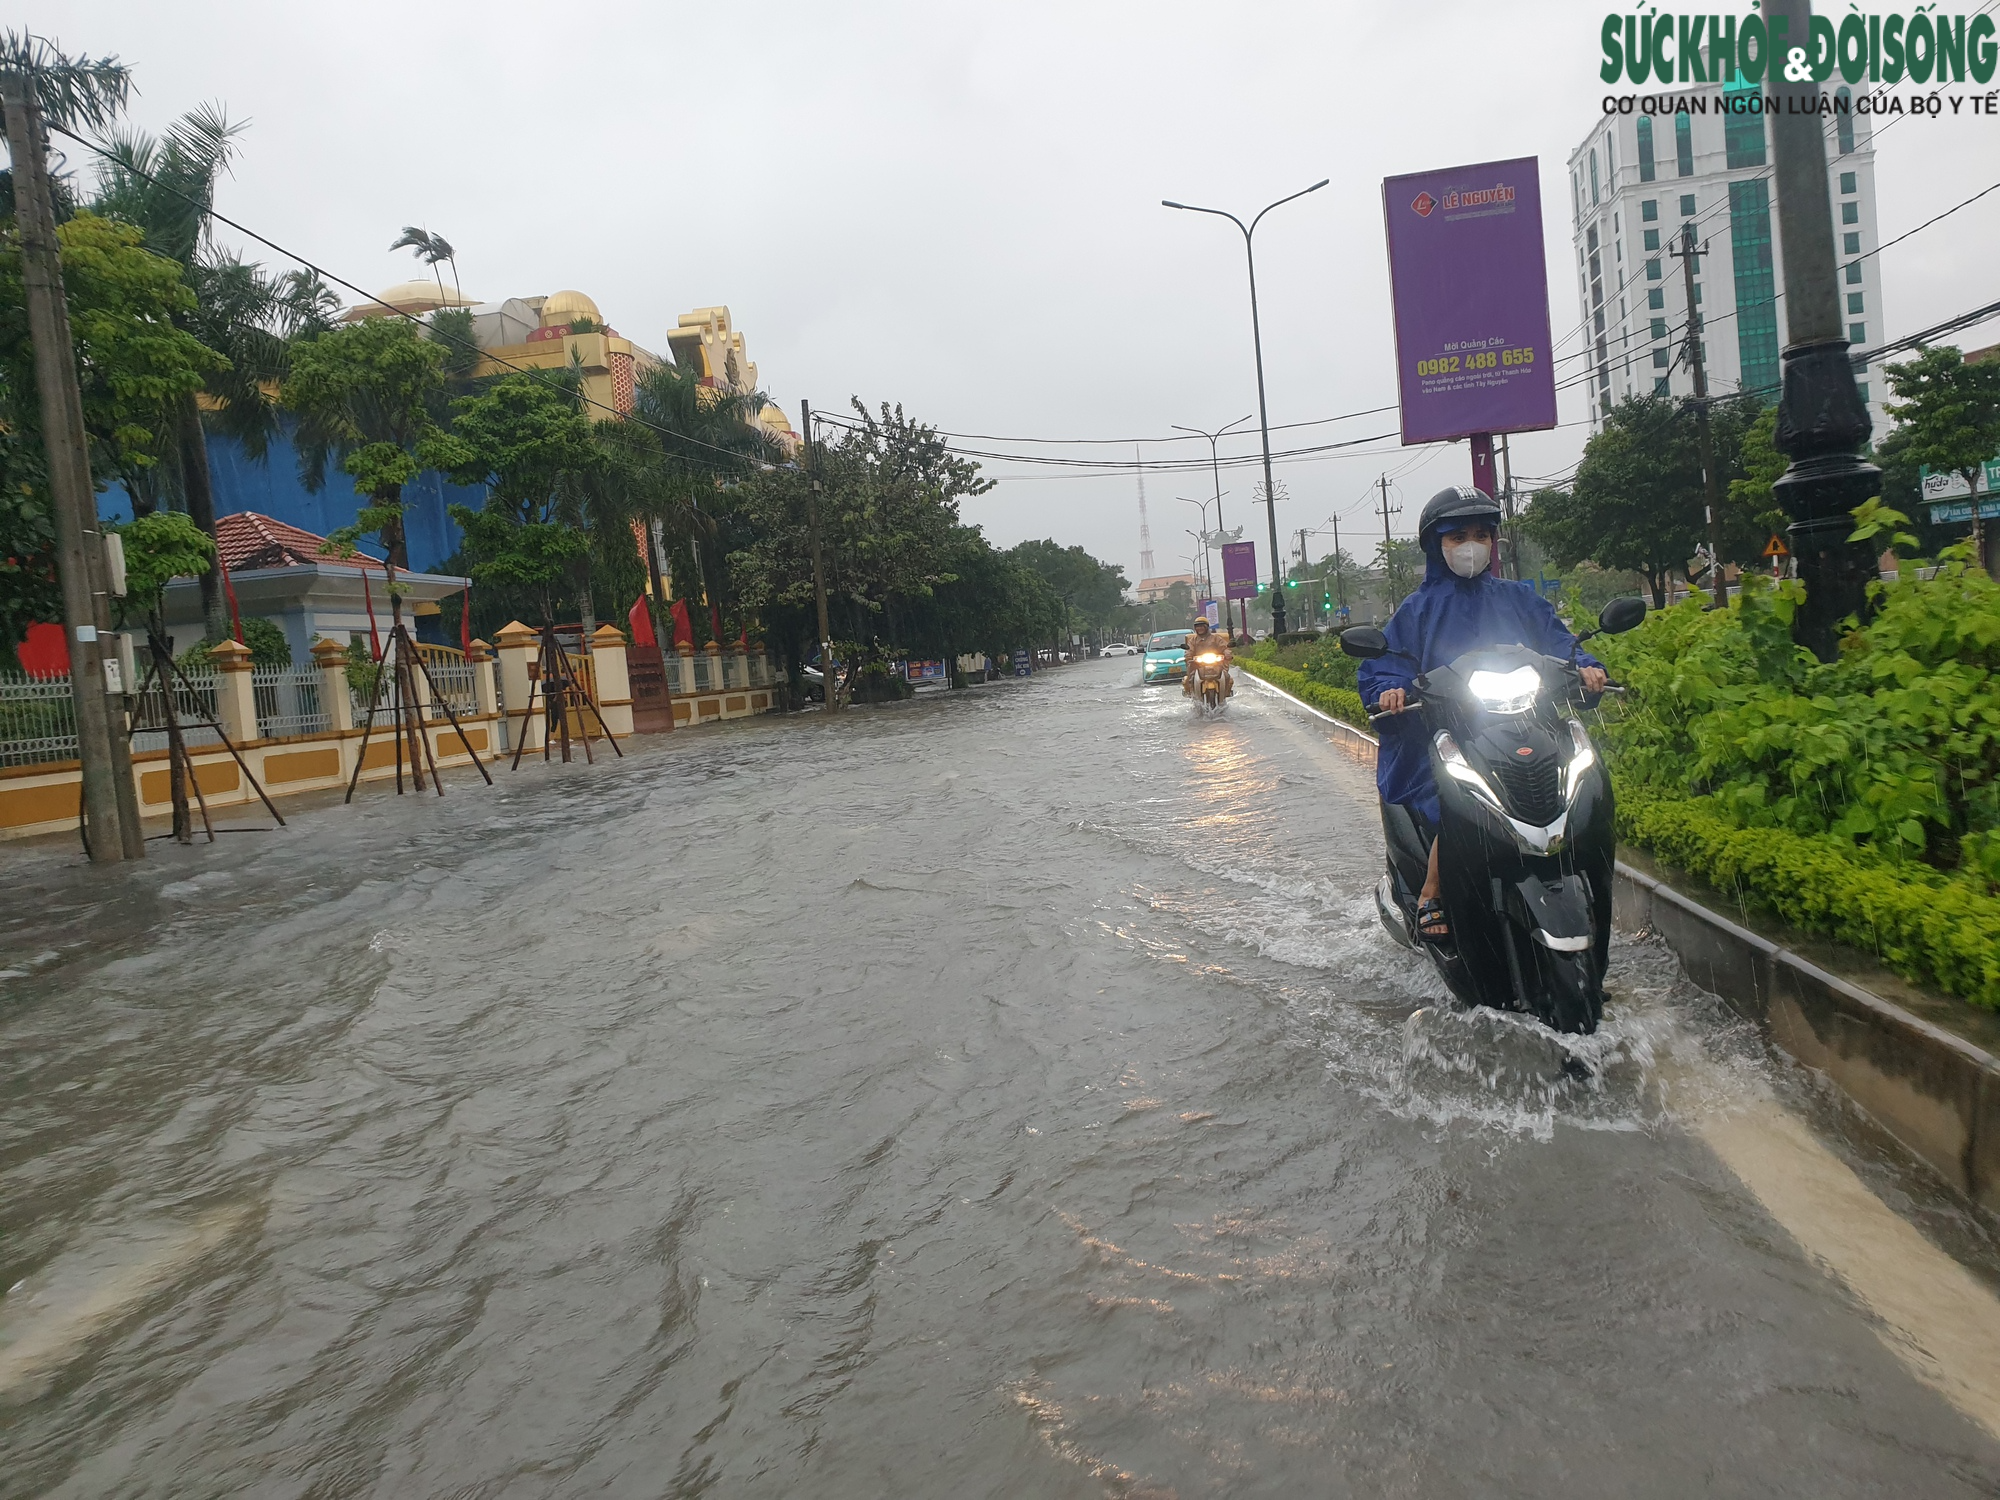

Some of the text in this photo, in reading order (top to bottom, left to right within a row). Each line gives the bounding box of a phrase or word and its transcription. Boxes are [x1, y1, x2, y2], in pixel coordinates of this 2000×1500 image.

[1443, 191, 1459, 210] LÊ
[1461, 183, 1515, 207] NGUYỄN
[1444, 337, 1505, 352] Mời Quảng Cáo
[1417, 347, 1535, 376] 0982 488 655
